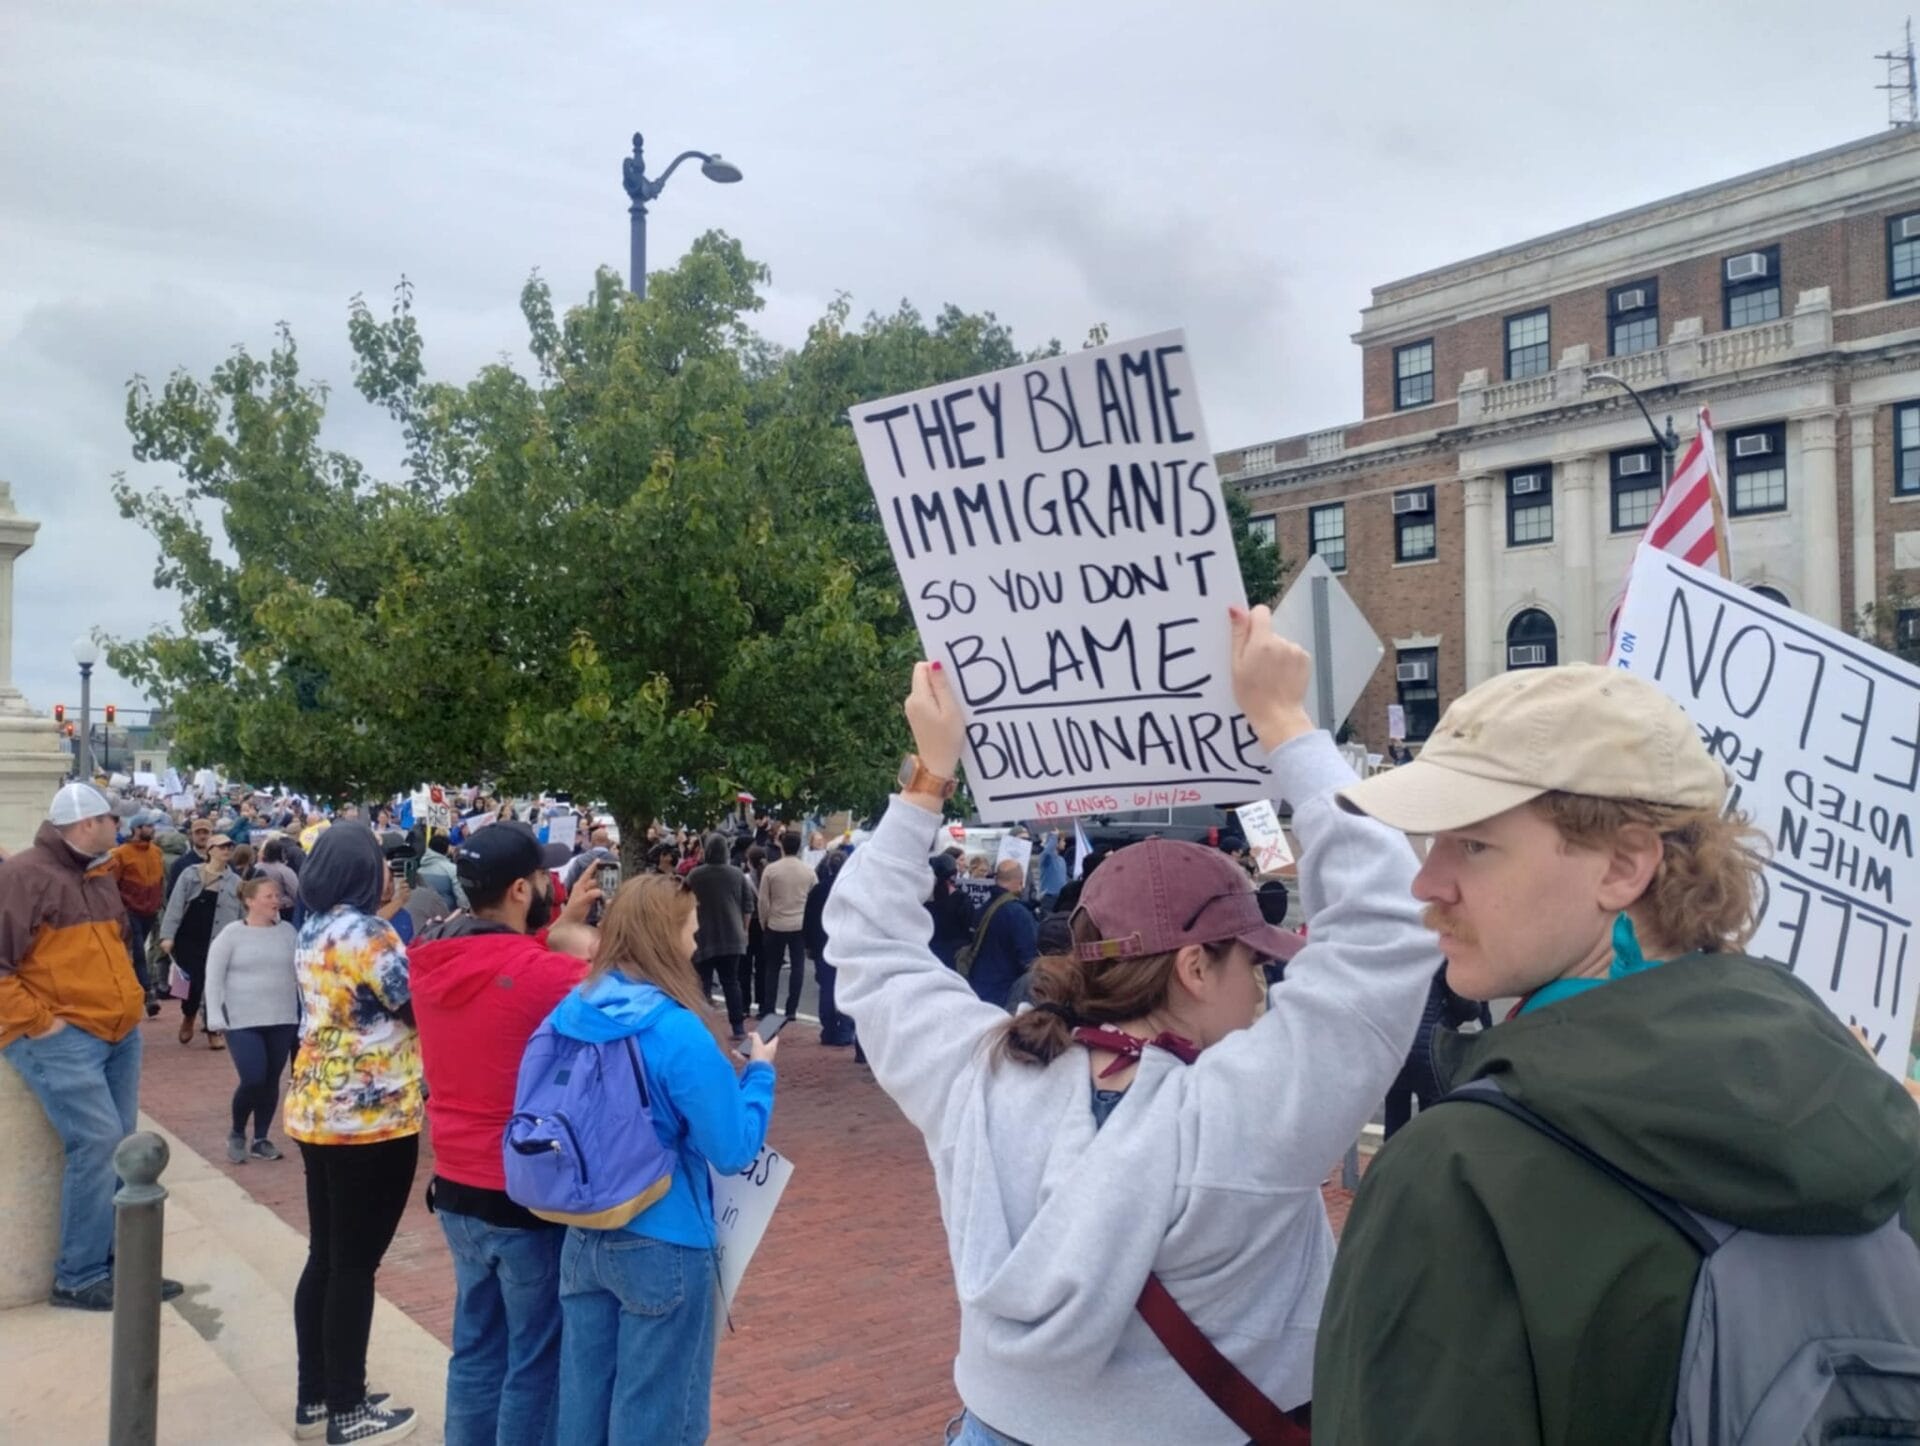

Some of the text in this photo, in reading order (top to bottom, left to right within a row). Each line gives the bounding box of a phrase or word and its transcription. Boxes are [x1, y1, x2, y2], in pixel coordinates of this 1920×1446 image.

[864, 344, 1195, 478] THEY BLAME
[892, 459, 1217, 559] IMMIGRANTS
[920, 550, 1216, 621] SO YOU DON'T
[944, 618, 1212, 707] BLAME
[1035, 800, 1058, 816] NO
[1065, 795, 1118, 814] KINGS
[1777, 806, 1893, 904] WHEN
